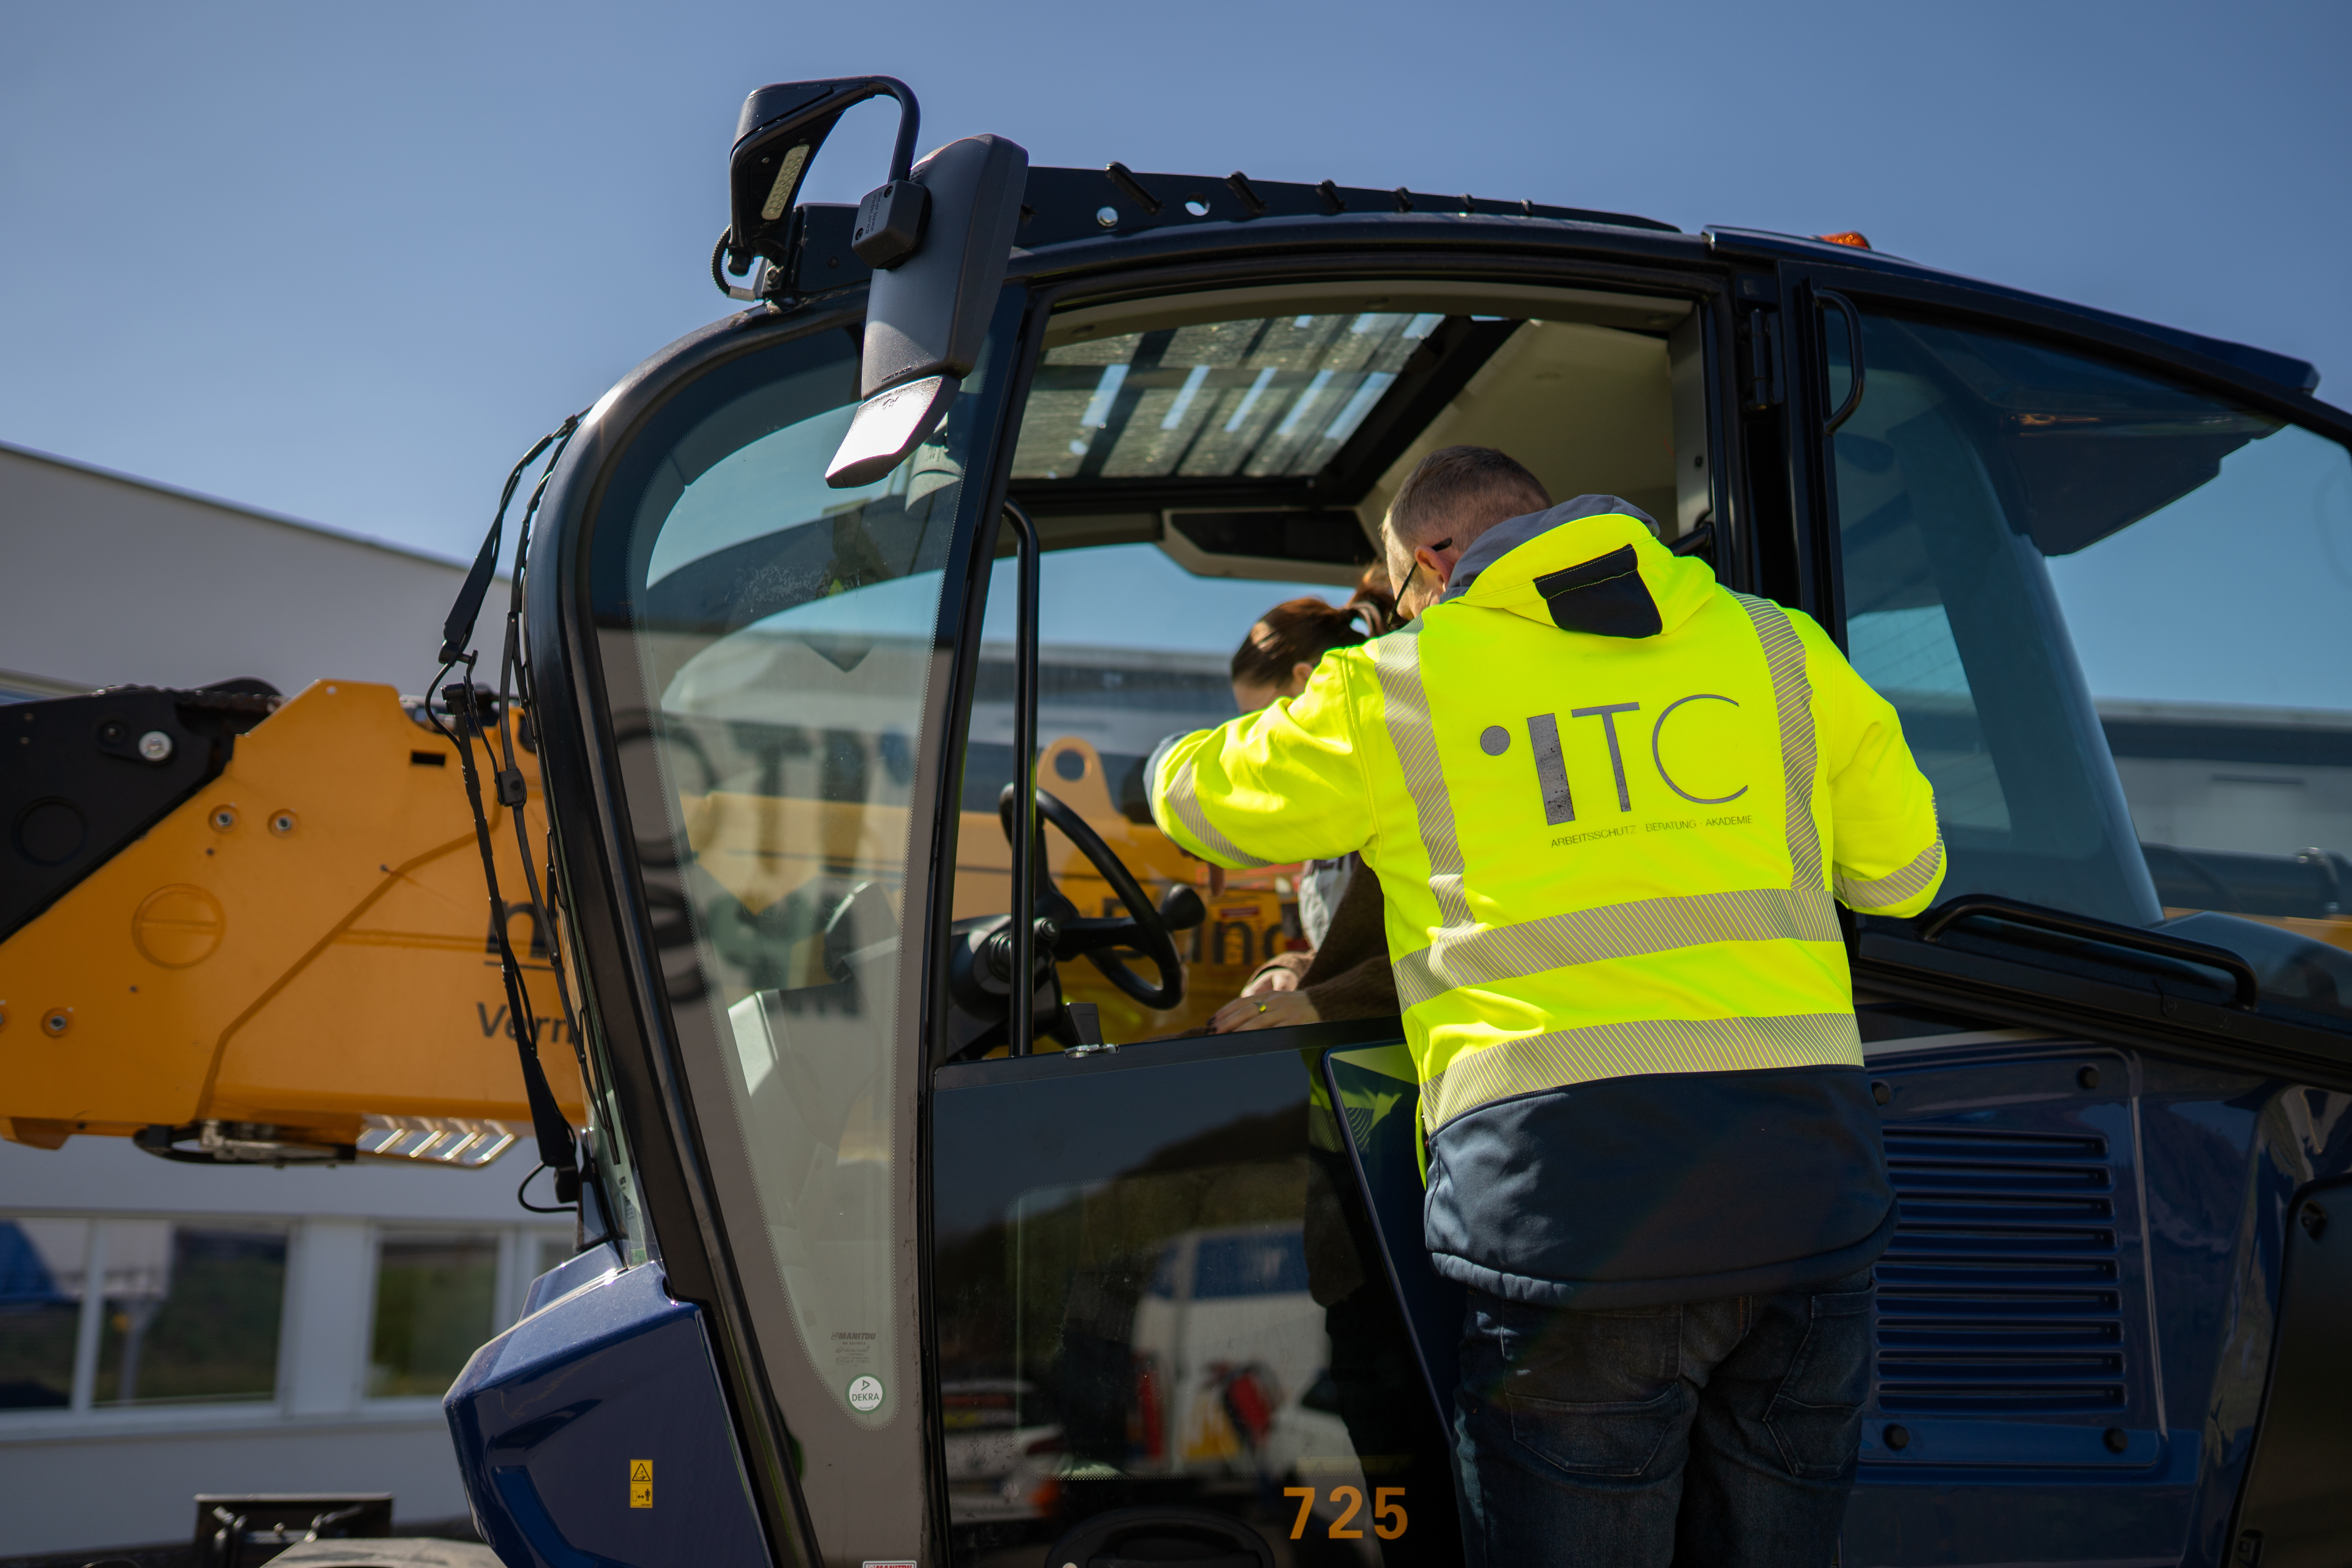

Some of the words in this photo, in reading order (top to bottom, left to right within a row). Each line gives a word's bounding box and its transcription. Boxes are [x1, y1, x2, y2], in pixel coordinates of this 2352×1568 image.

[1526, 694, 1748, 826] ITC
[1551, 825, 1637, 848] ARBEITSSCHUTZ
[1646, 820, 1697, 832] BERATUNG
[1706, 815, 1753, 826] AKADEMIE
[852, 1393, 880, 1402] DEKRA
[1284, 1485, 1408, 1540] 725
